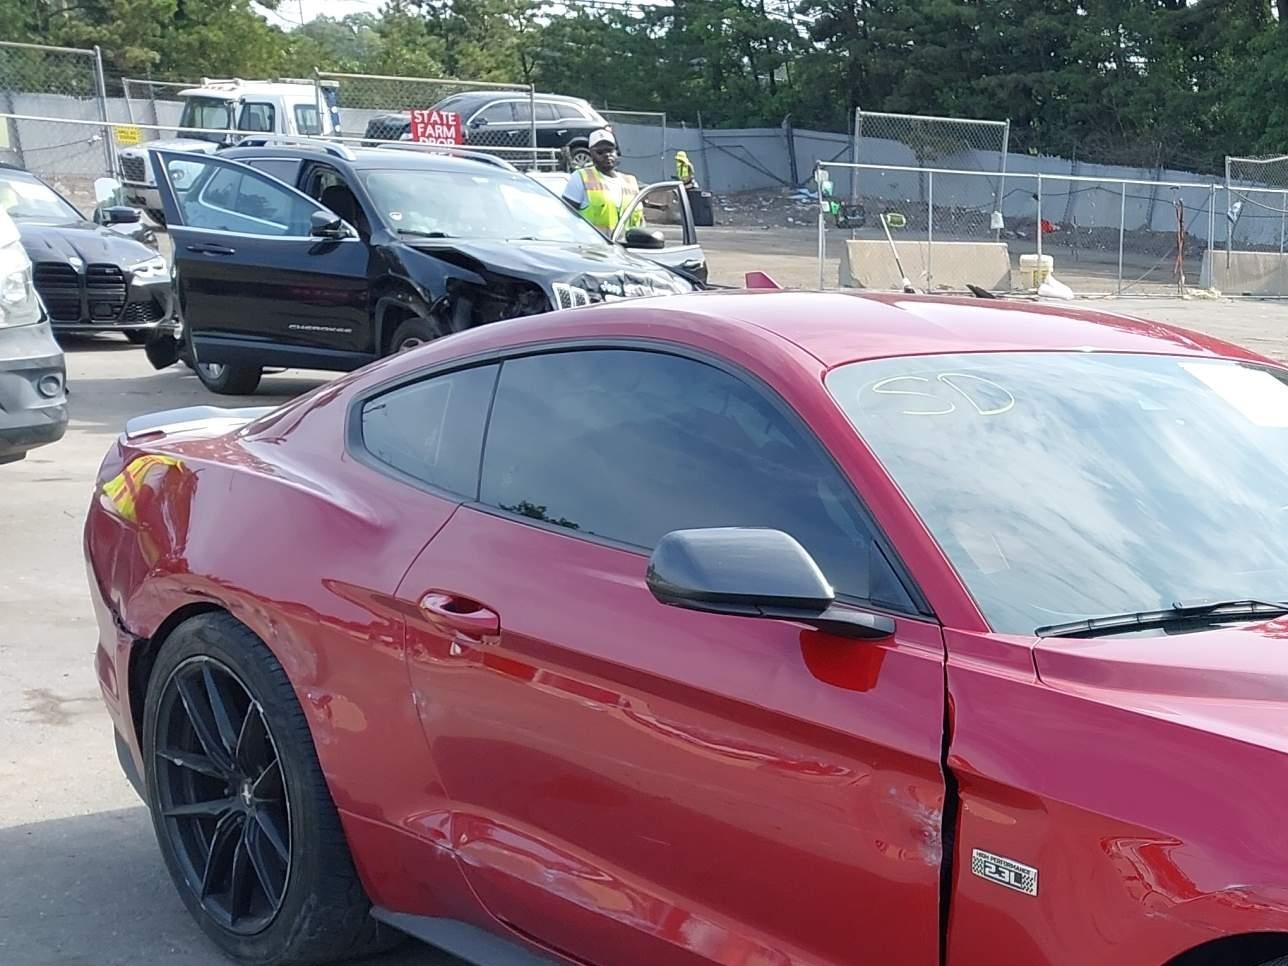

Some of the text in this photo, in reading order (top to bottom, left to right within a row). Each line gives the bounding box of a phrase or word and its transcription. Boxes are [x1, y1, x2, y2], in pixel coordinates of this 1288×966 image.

[413, 110, 456, 125] STATE
[417, 123, 456, 138] FARM
[288, 324, 352, 333] CHEROKEE
[990, 855, 1031, 875] PERFORMANCE
